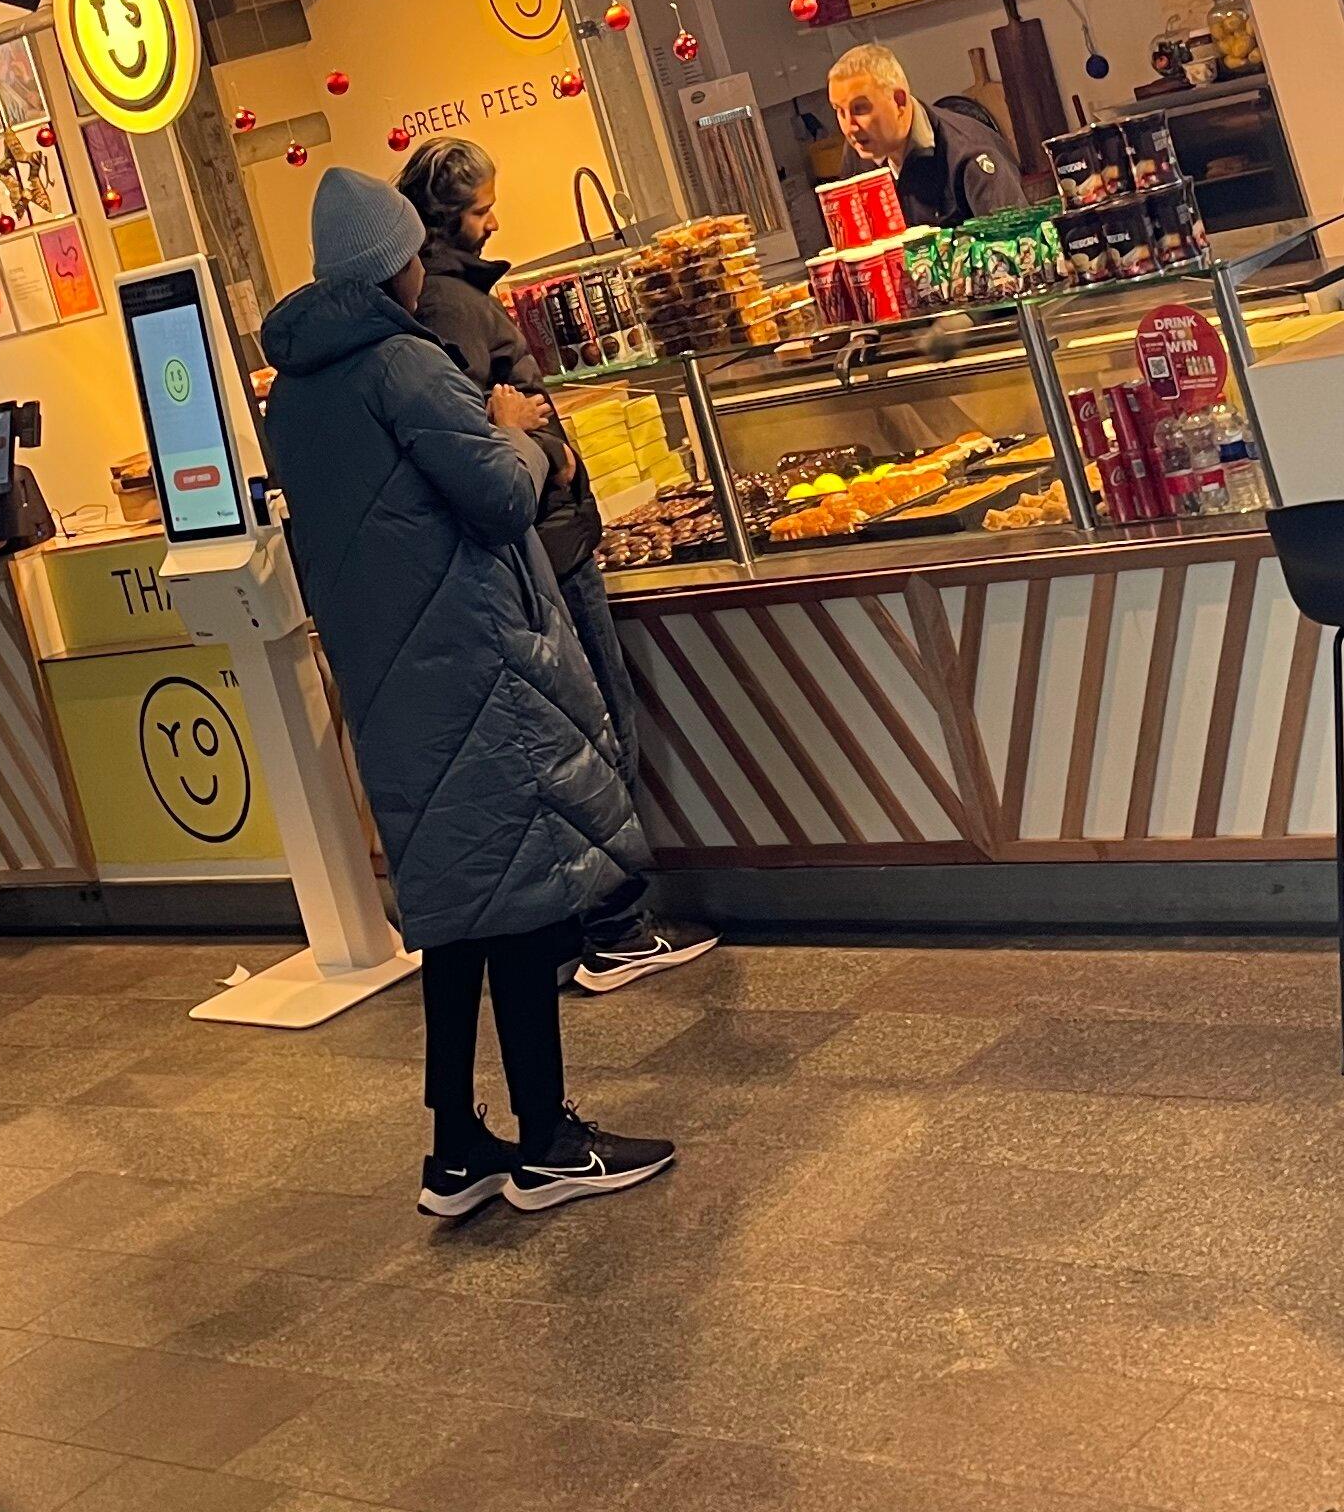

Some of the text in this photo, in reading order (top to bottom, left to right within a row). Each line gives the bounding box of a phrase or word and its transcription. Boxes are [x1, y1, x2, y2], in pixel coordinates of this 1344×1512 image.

[401, 99, 472, 140] GREEK
[481, 81, 538, 119] PIES
[1153, 315, 1197, 331] DRINK
[1166, 338, 1198, 354] WIN
